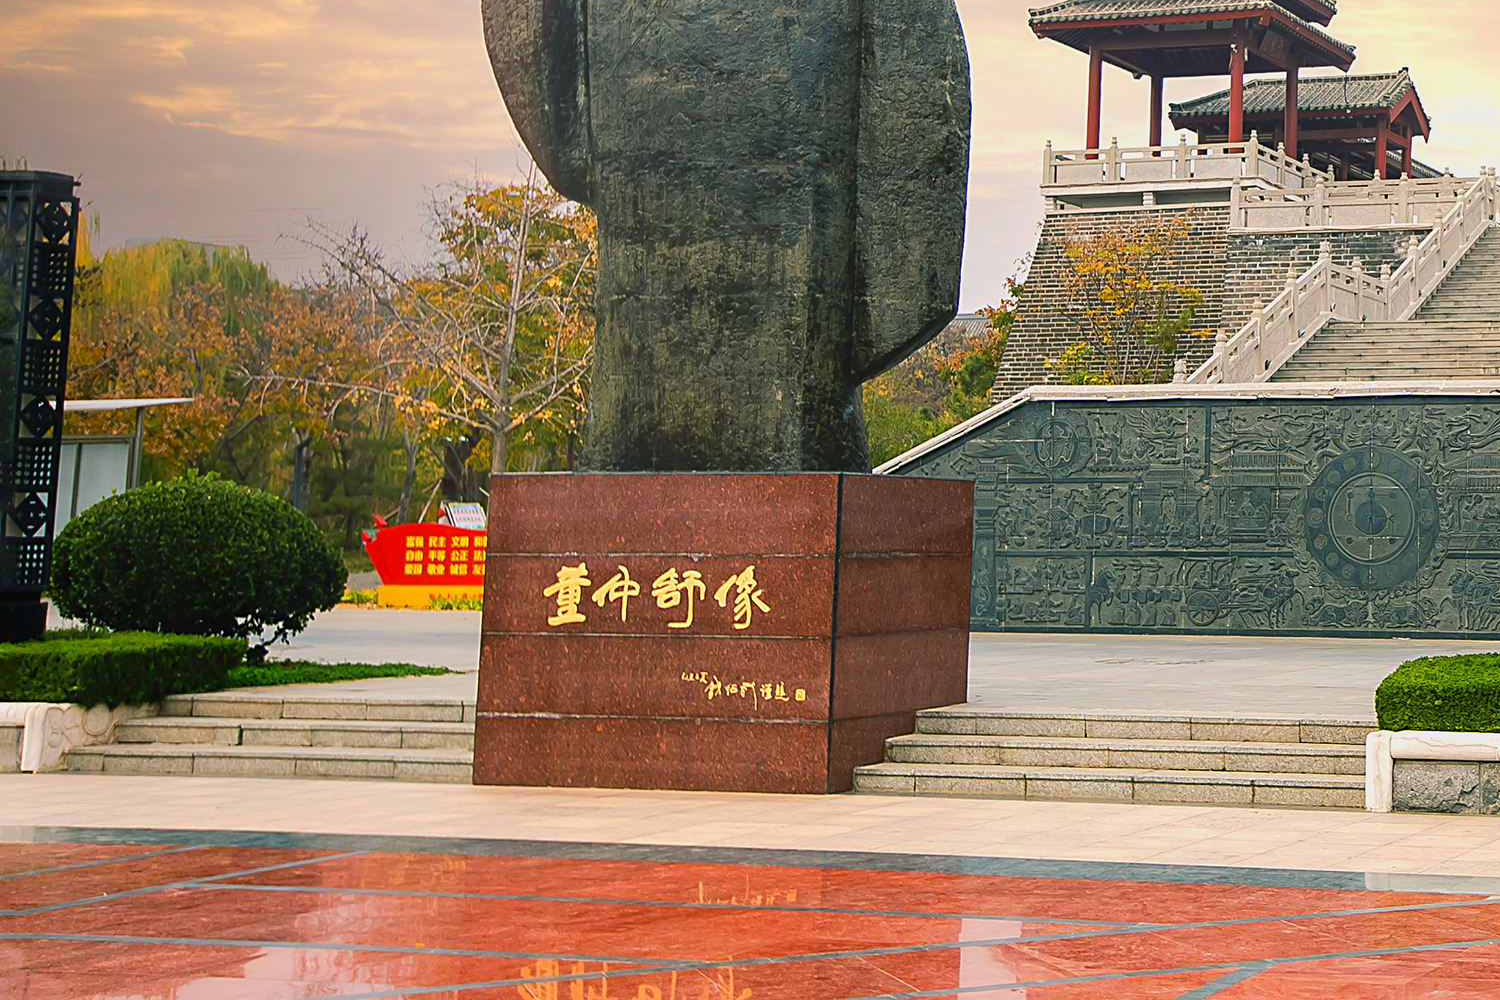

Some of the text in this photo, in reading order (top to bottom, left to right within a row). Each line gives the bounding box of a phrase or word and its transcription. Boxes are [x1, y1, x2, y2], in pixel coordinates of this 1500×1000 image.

[405, 535, 424, 548] 富强
[428, 535, 446, 548] 民主
[451, 535, 469, 548] 文明
[405, 549, 423, 562] 自由
[428, 549, 446, 562] 平等
[451, 549, 469, 562] 公正
[404, 563, 423, 576] 爱国
[427, 563, 446, 576] 敬业
[449, 563, 468, 576] 诚信
[543, 561, 771, 630] 董仲舒像
